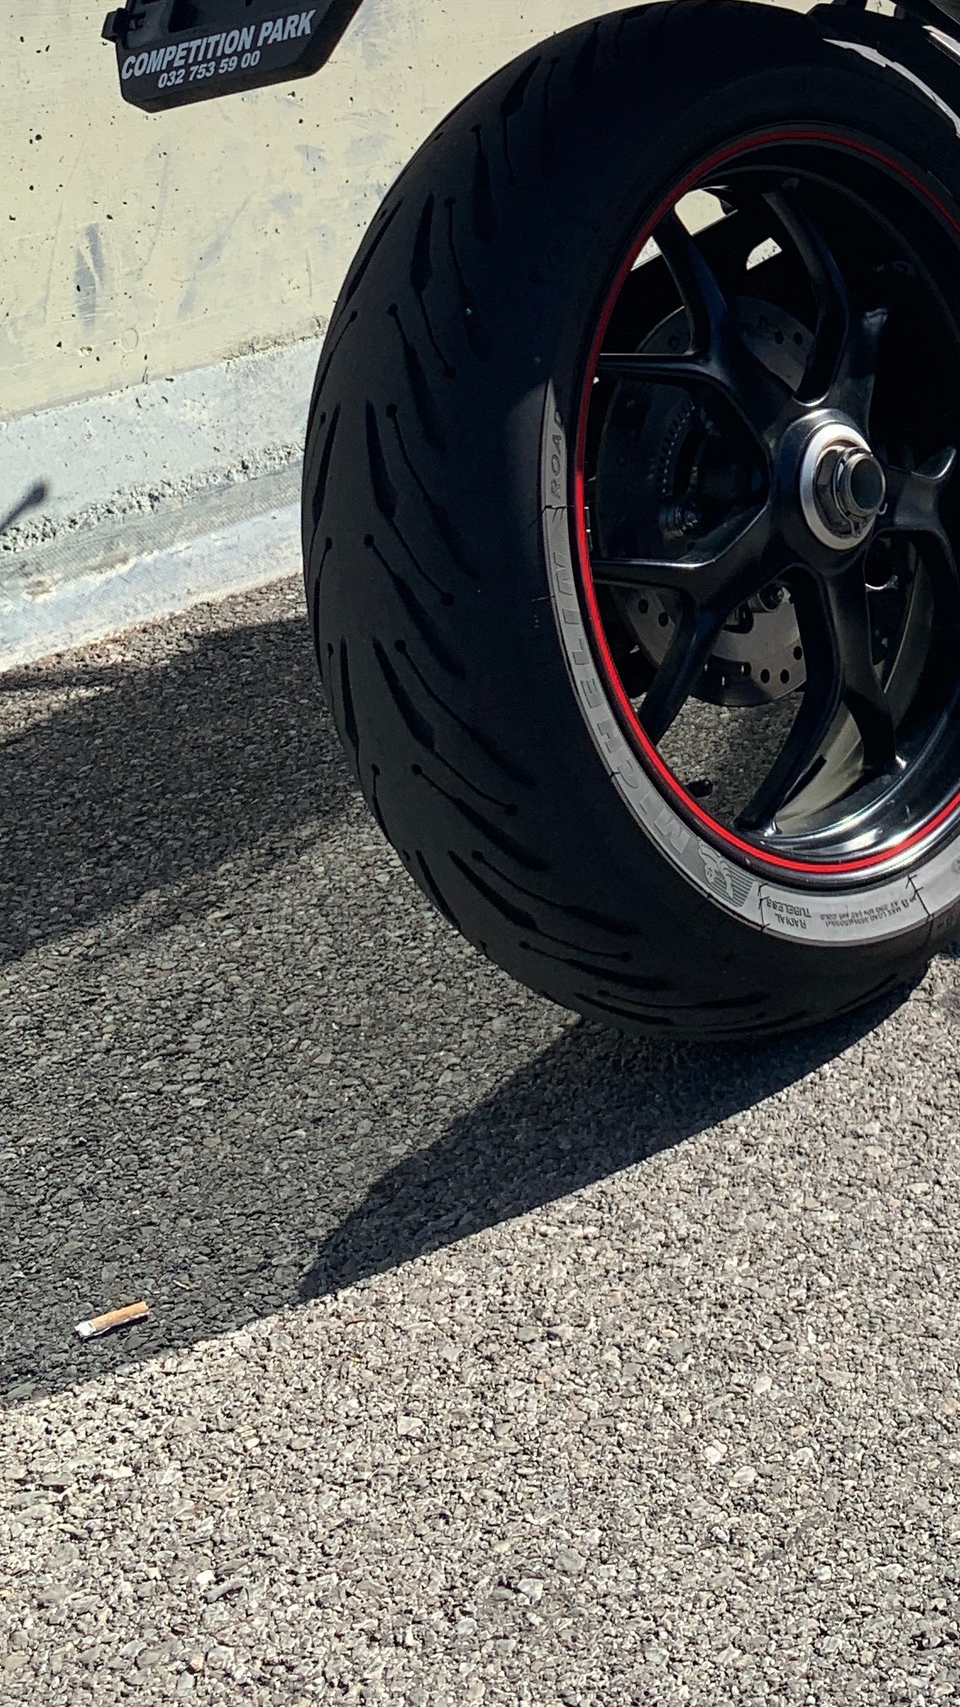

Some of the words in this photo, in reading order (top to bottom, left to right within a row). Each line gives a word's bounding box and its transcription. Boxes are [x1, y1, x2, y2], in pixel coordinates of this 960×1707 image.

[121, 25, 256, 80] COMPETITION
[257, 9, 317, 47] PARK
[157, 69, 184, 89] 032
[188, 61, 215, 82] 753
[218, 56, 237, 74] 59
[241, 50, 261, 68] 00
[553, 551, 690, 855] MICHELIN
